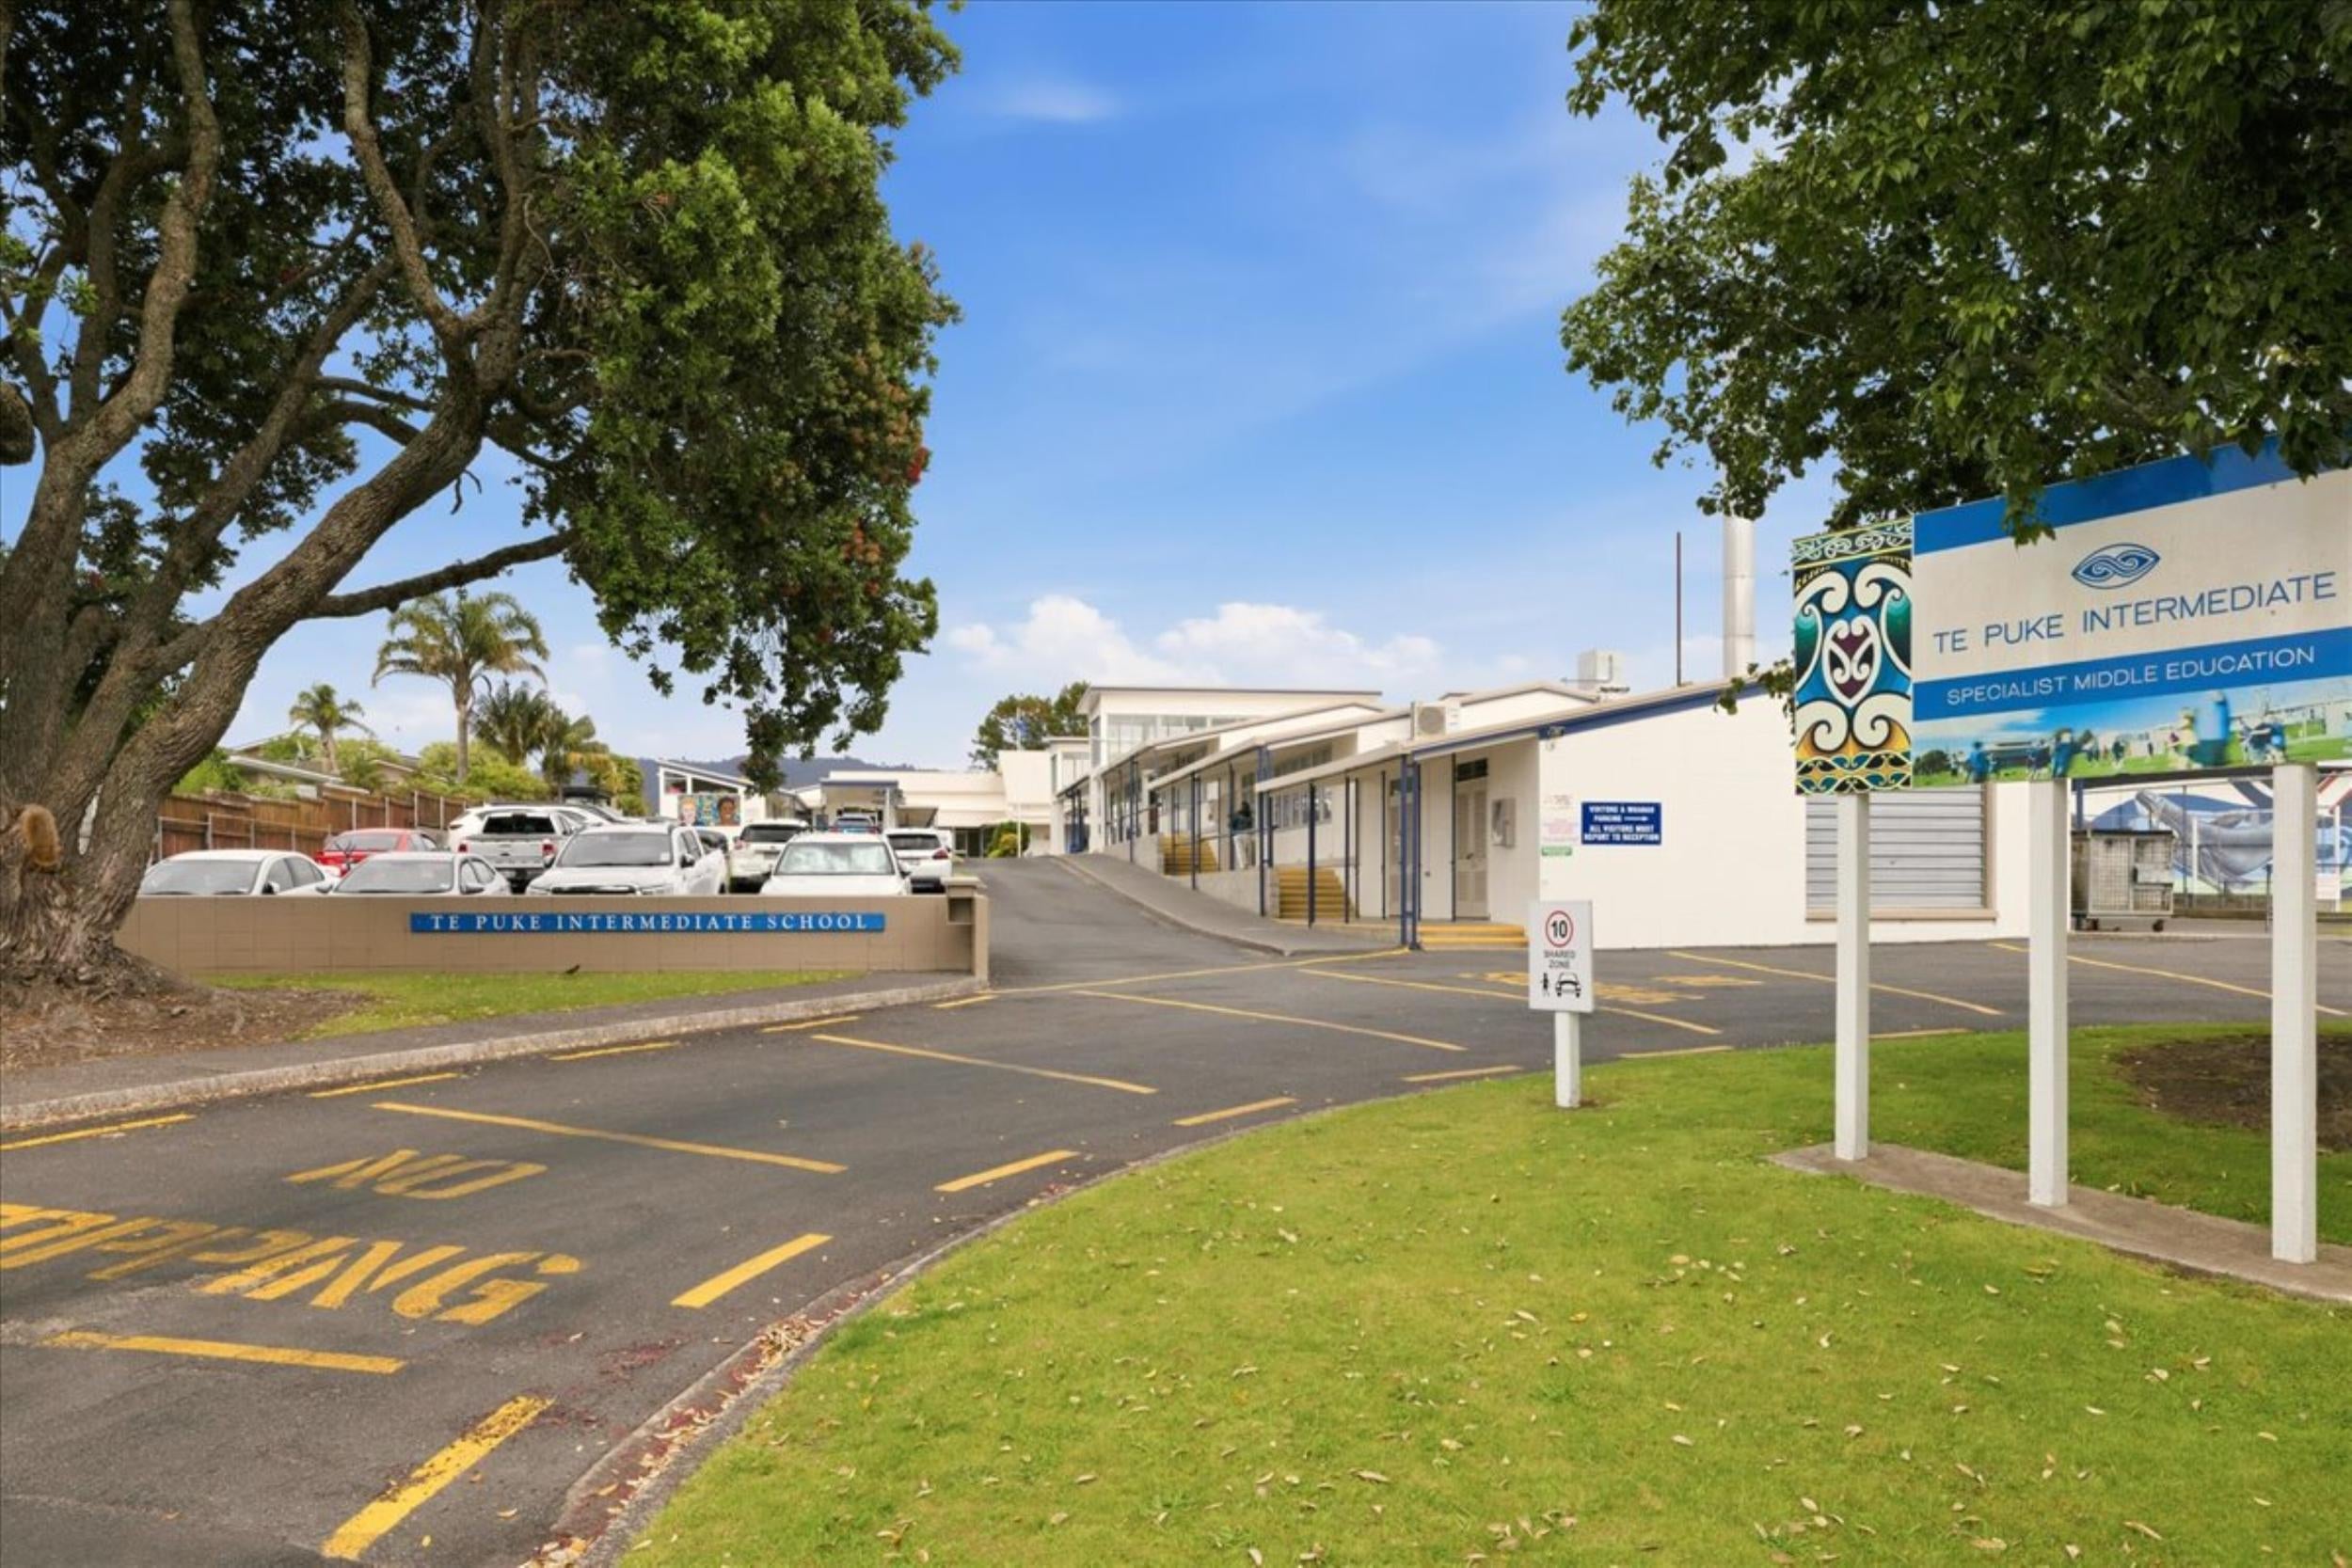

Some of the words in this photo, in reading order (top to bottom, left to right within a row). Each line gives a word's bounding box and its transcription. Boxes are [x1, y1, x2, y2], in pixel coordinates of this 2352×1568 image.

[1933, 628, 1968, 654] TE
[1984, 614, 2064, 646] PUKE
[2082, 572, 2336, 633] INTERMEDIATE
[1947, 676, 2067, 705] SPECIALIST
[2074, 662, 2157, 689] MIDDLE
[2166, 646, 2315, 680] EDUCATION
[431, 914, 460, 930] TE
[475, 914, 542, 930] PUKE
[556, 914, 753, 930] INTERMEDIATE
[767, 914, 868, 929] SCHOOL
[1550, 919, 1568, 939] 10
[1543, 950, 1576, 959] SHARED
[1549, 959, 1570, 969] ZONE
[283, 1148, 548, 1200] NO
